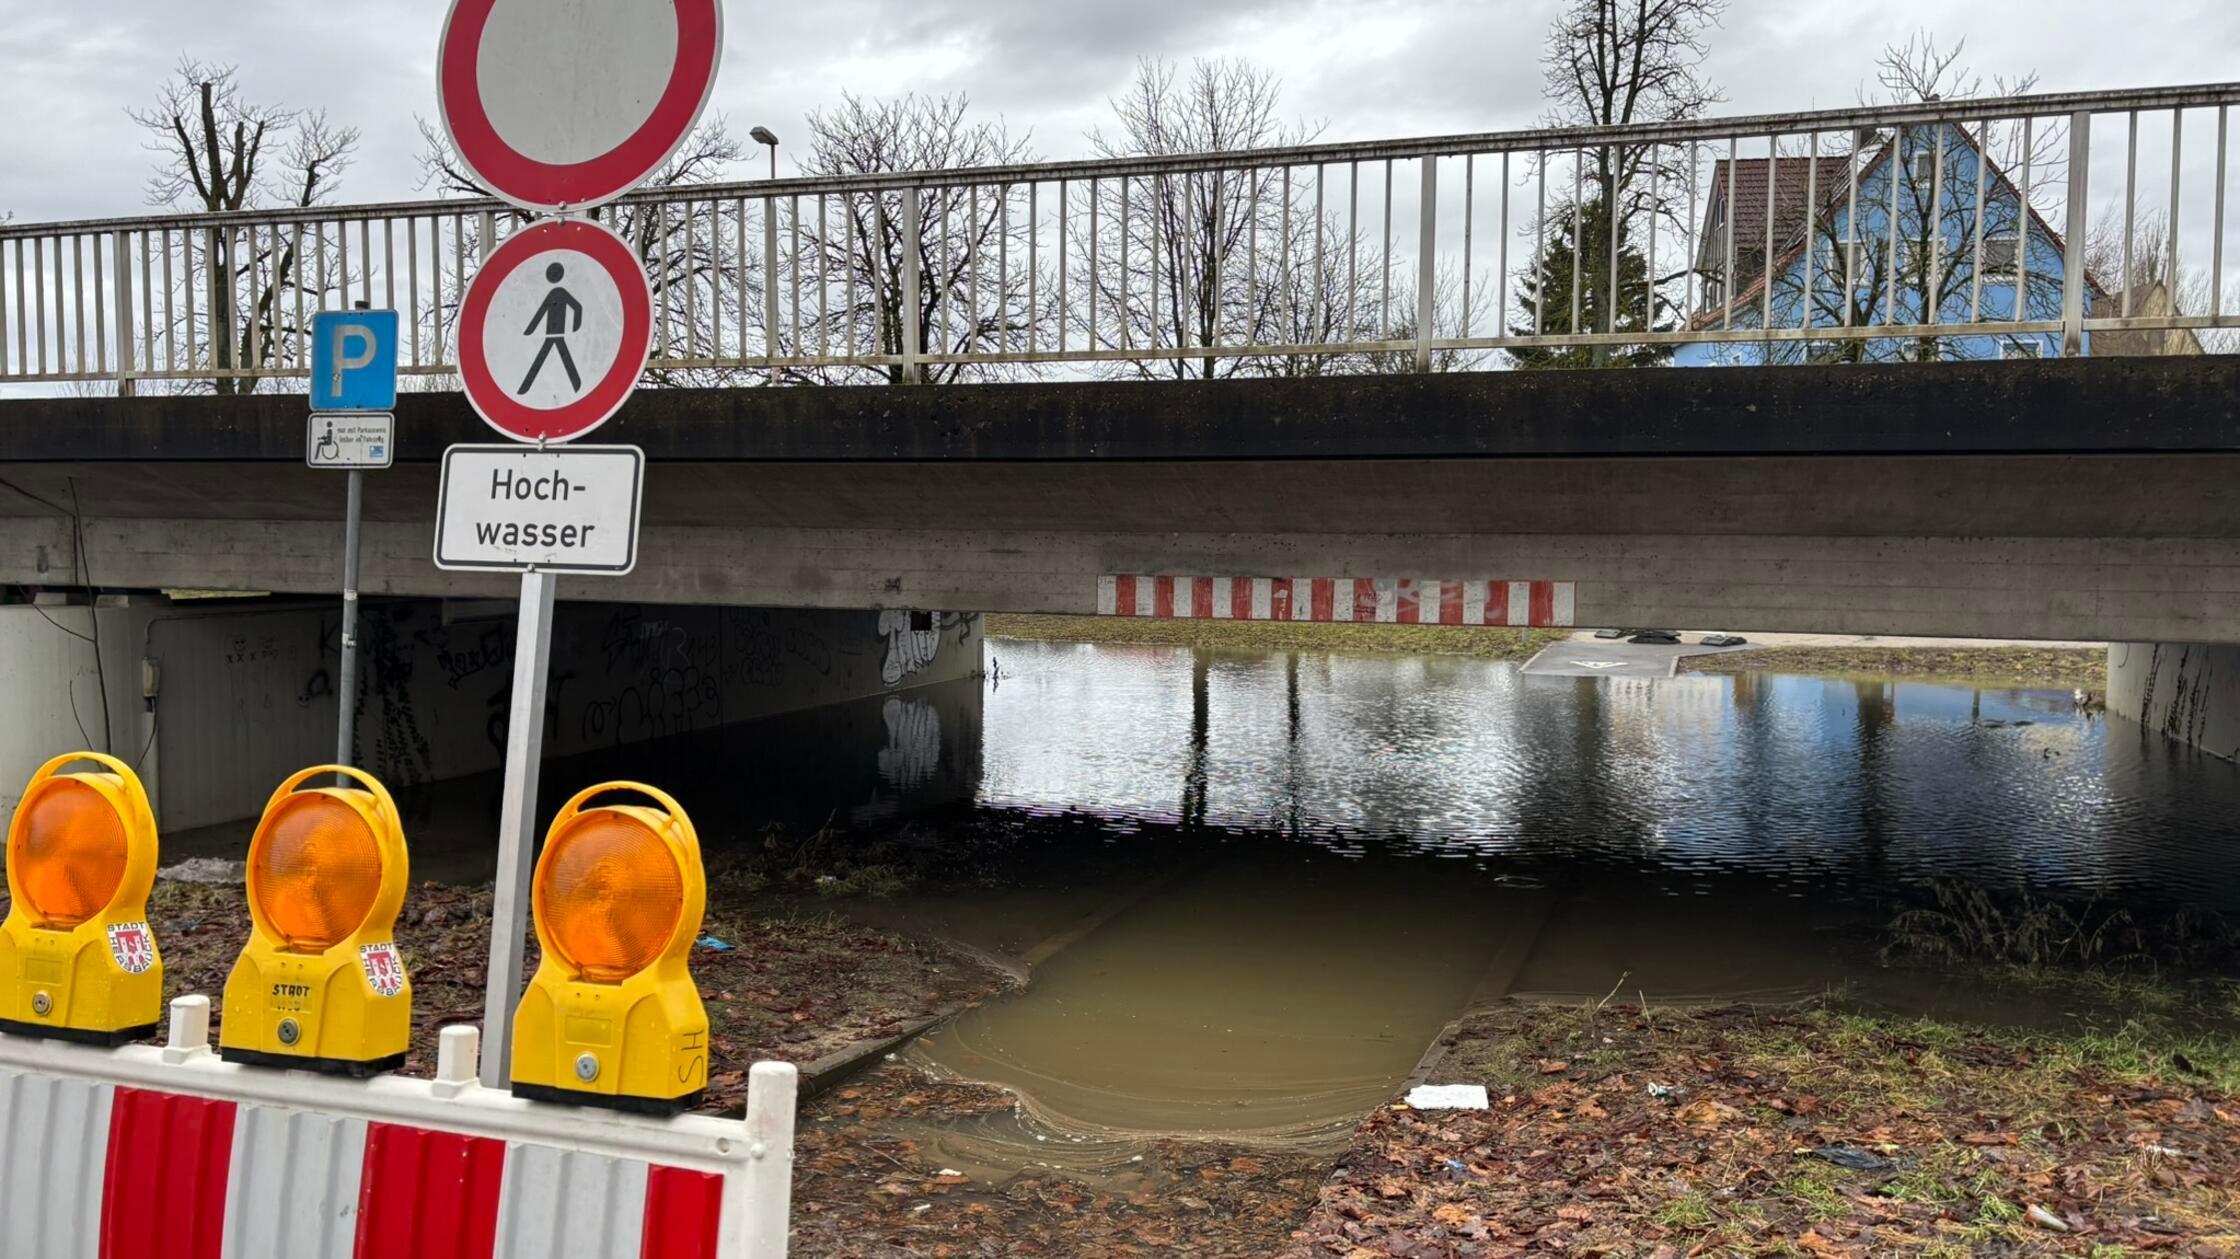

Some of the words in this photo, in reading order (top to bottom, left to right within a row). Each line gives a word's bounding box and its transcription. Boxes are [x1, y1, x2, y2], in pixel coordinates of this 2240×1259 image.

[331, 324, 377, 398] P
[490, 468, 587, 502] Hoch-
[475, 522, 596, 549] wasser
[107, 921, 145, 931] STADT
[360, 943, 393, 953] STADT
[272, 983, 310, 997] STADT
